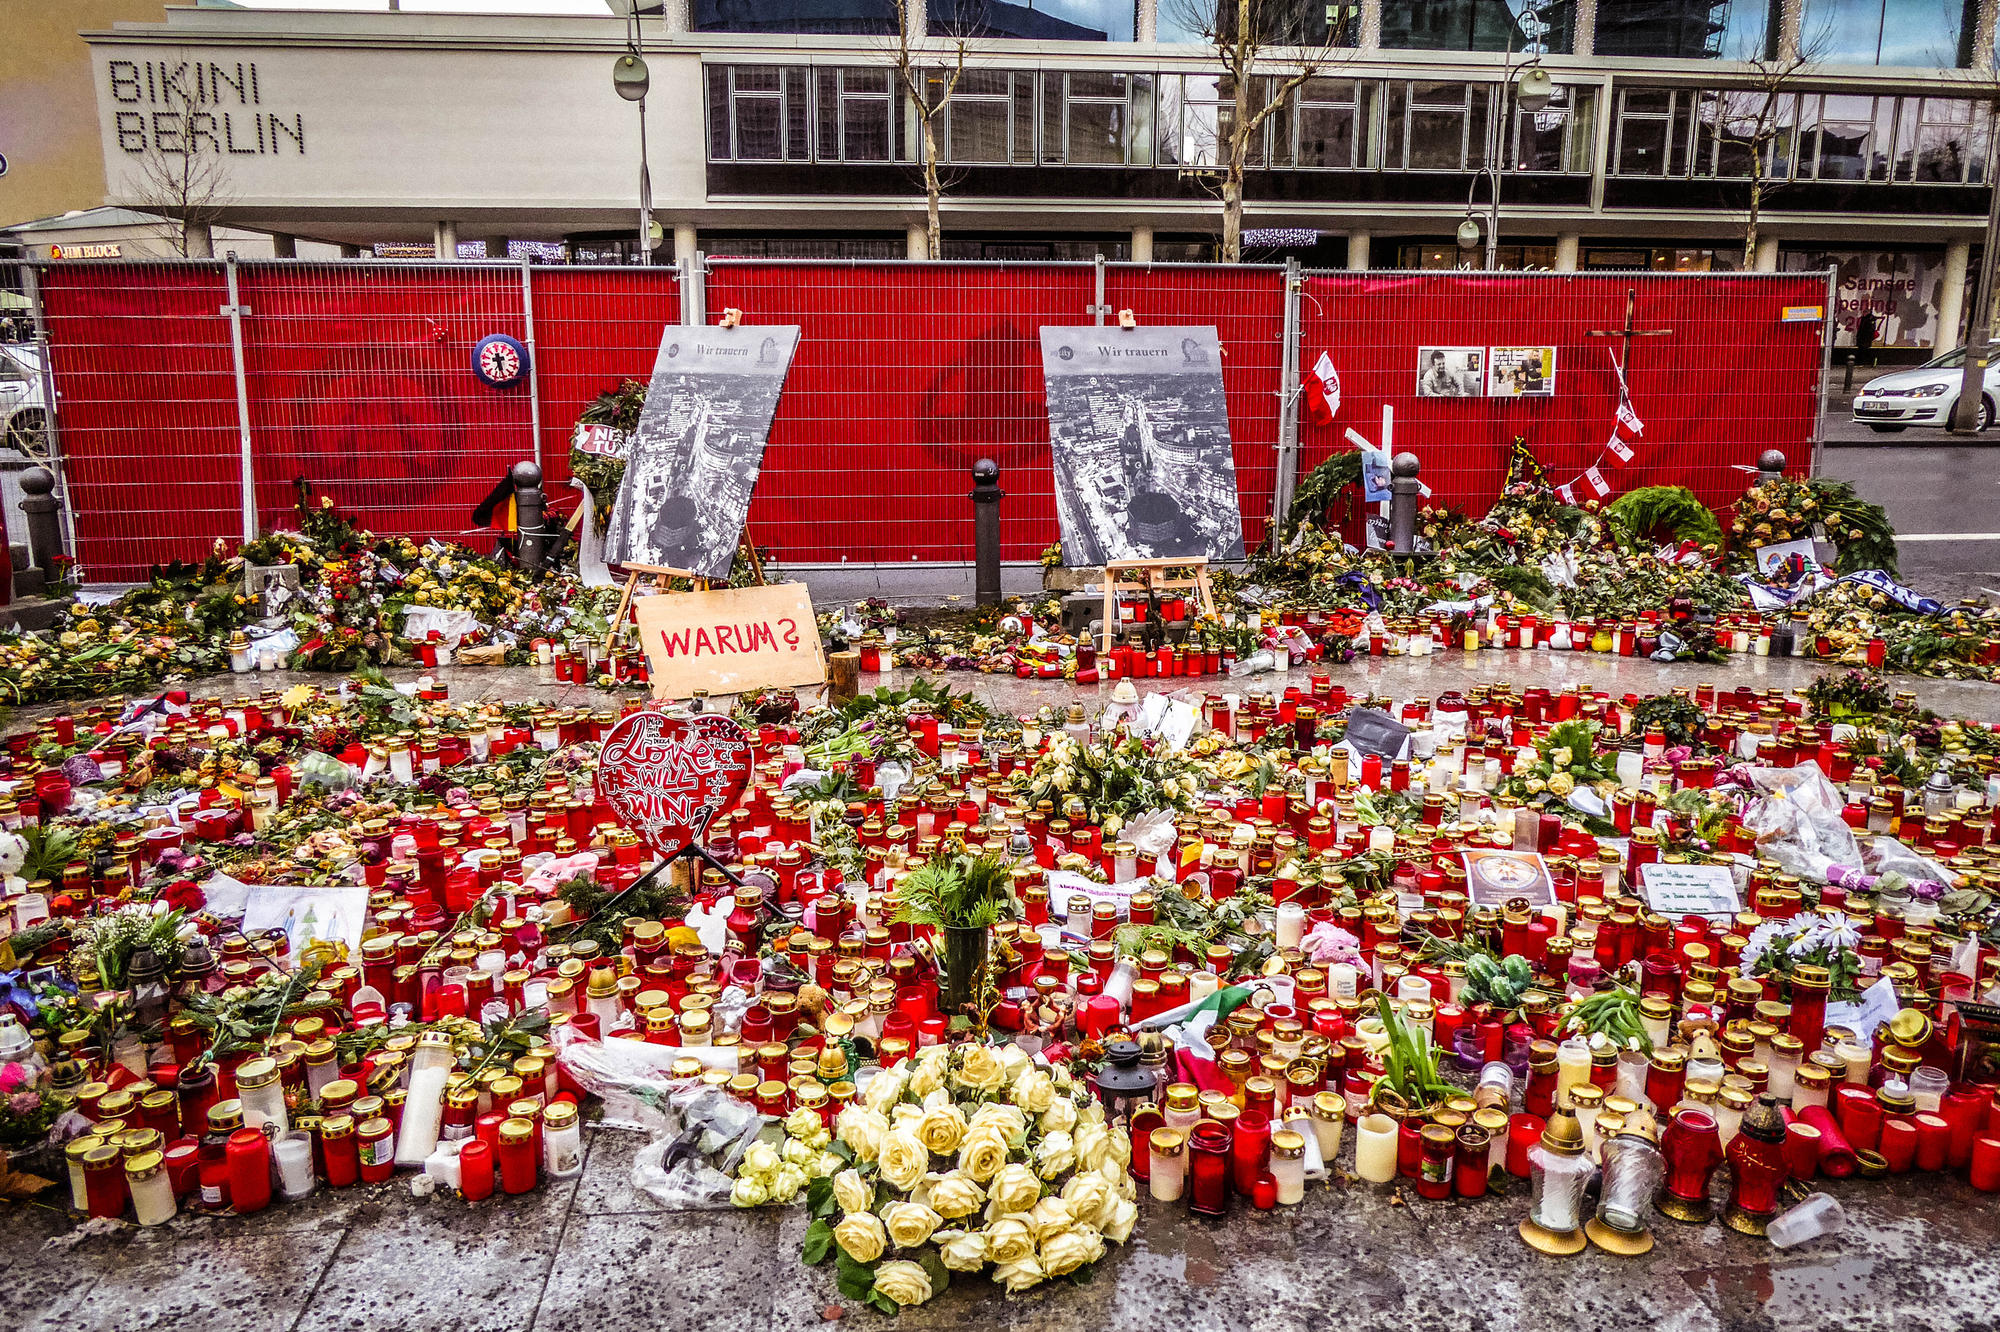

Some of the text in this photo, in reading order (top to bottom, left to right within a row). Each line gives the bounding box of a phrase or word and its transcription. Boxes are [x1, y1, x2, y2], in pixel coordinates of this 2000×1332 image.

[109, 60, 260, 105] BIKINI
[116, 111, 305, 155] BERLIN
[84, 244, 121, 258] BLOCK
[1836, 298, 1898, 316] pening
[697, 344, 748, 356] Wir trauern
[1098, 346, 1168, 357] Wir trauern
[661, 618, 799, 658] WARUM?
[603, 716, 715, 774] Love
[714, 739, 744, 750] Heroes
[721, 750, 732, 760] of
[714, 761, 745, 770] Freedom
[623, 792, 691, 825] WIN
[665, 839, 679, 848] RIP
